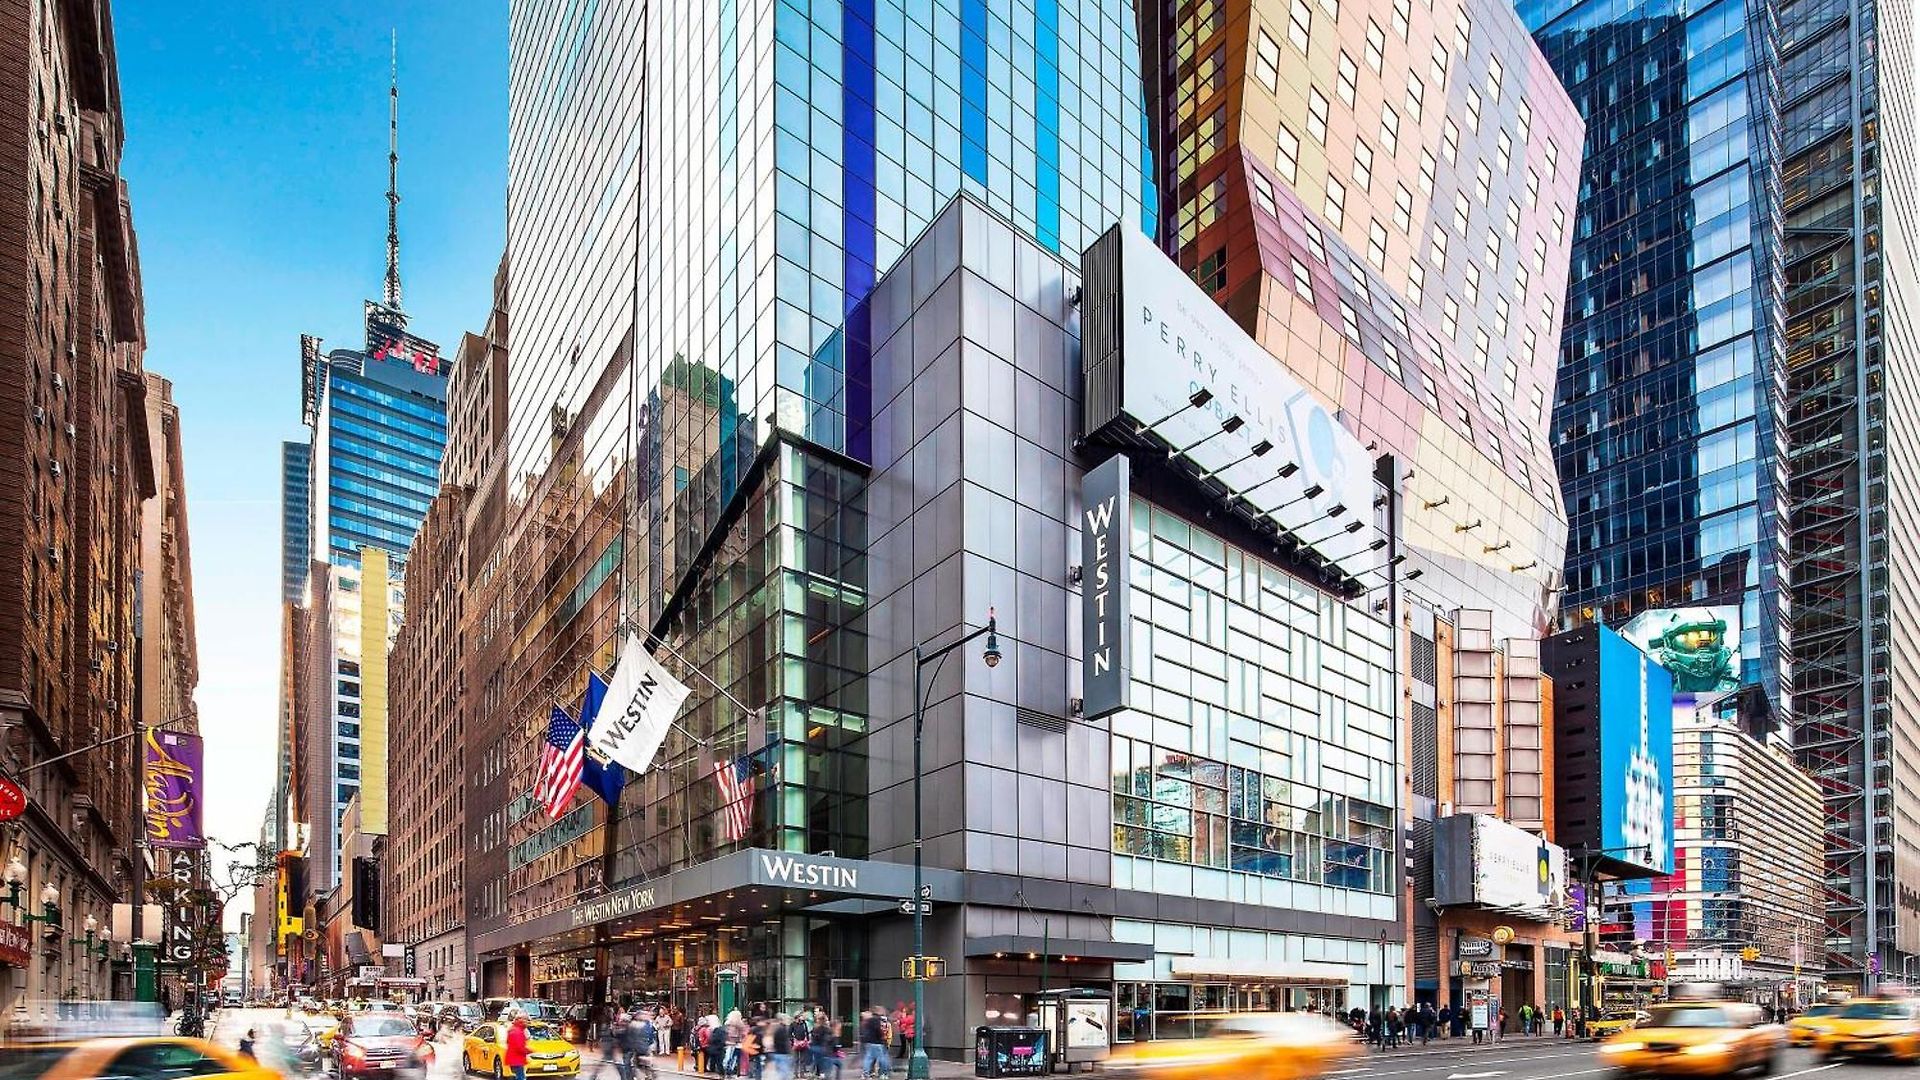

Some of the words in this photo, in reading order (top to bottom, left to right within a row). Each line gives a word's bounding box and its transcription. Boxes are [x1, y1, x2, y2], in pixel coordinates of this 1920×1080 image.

[1143, 305, 1217, 385] PERRY
[1230, 383, 1287, 444] ELLIS
[1086, 494, 1116, 677] WESTIN
[599, 669, 659, 750] WESTIN
[173, 850, 192, 960] ARKING
[571, 908, 584, 926] THE
[584, 901, 610, 923] WESTIN
[611, 895, 631, 916] NEW
[631, 887, 655, 910] YORK
[761, 854, 857, 888] WESTIN
